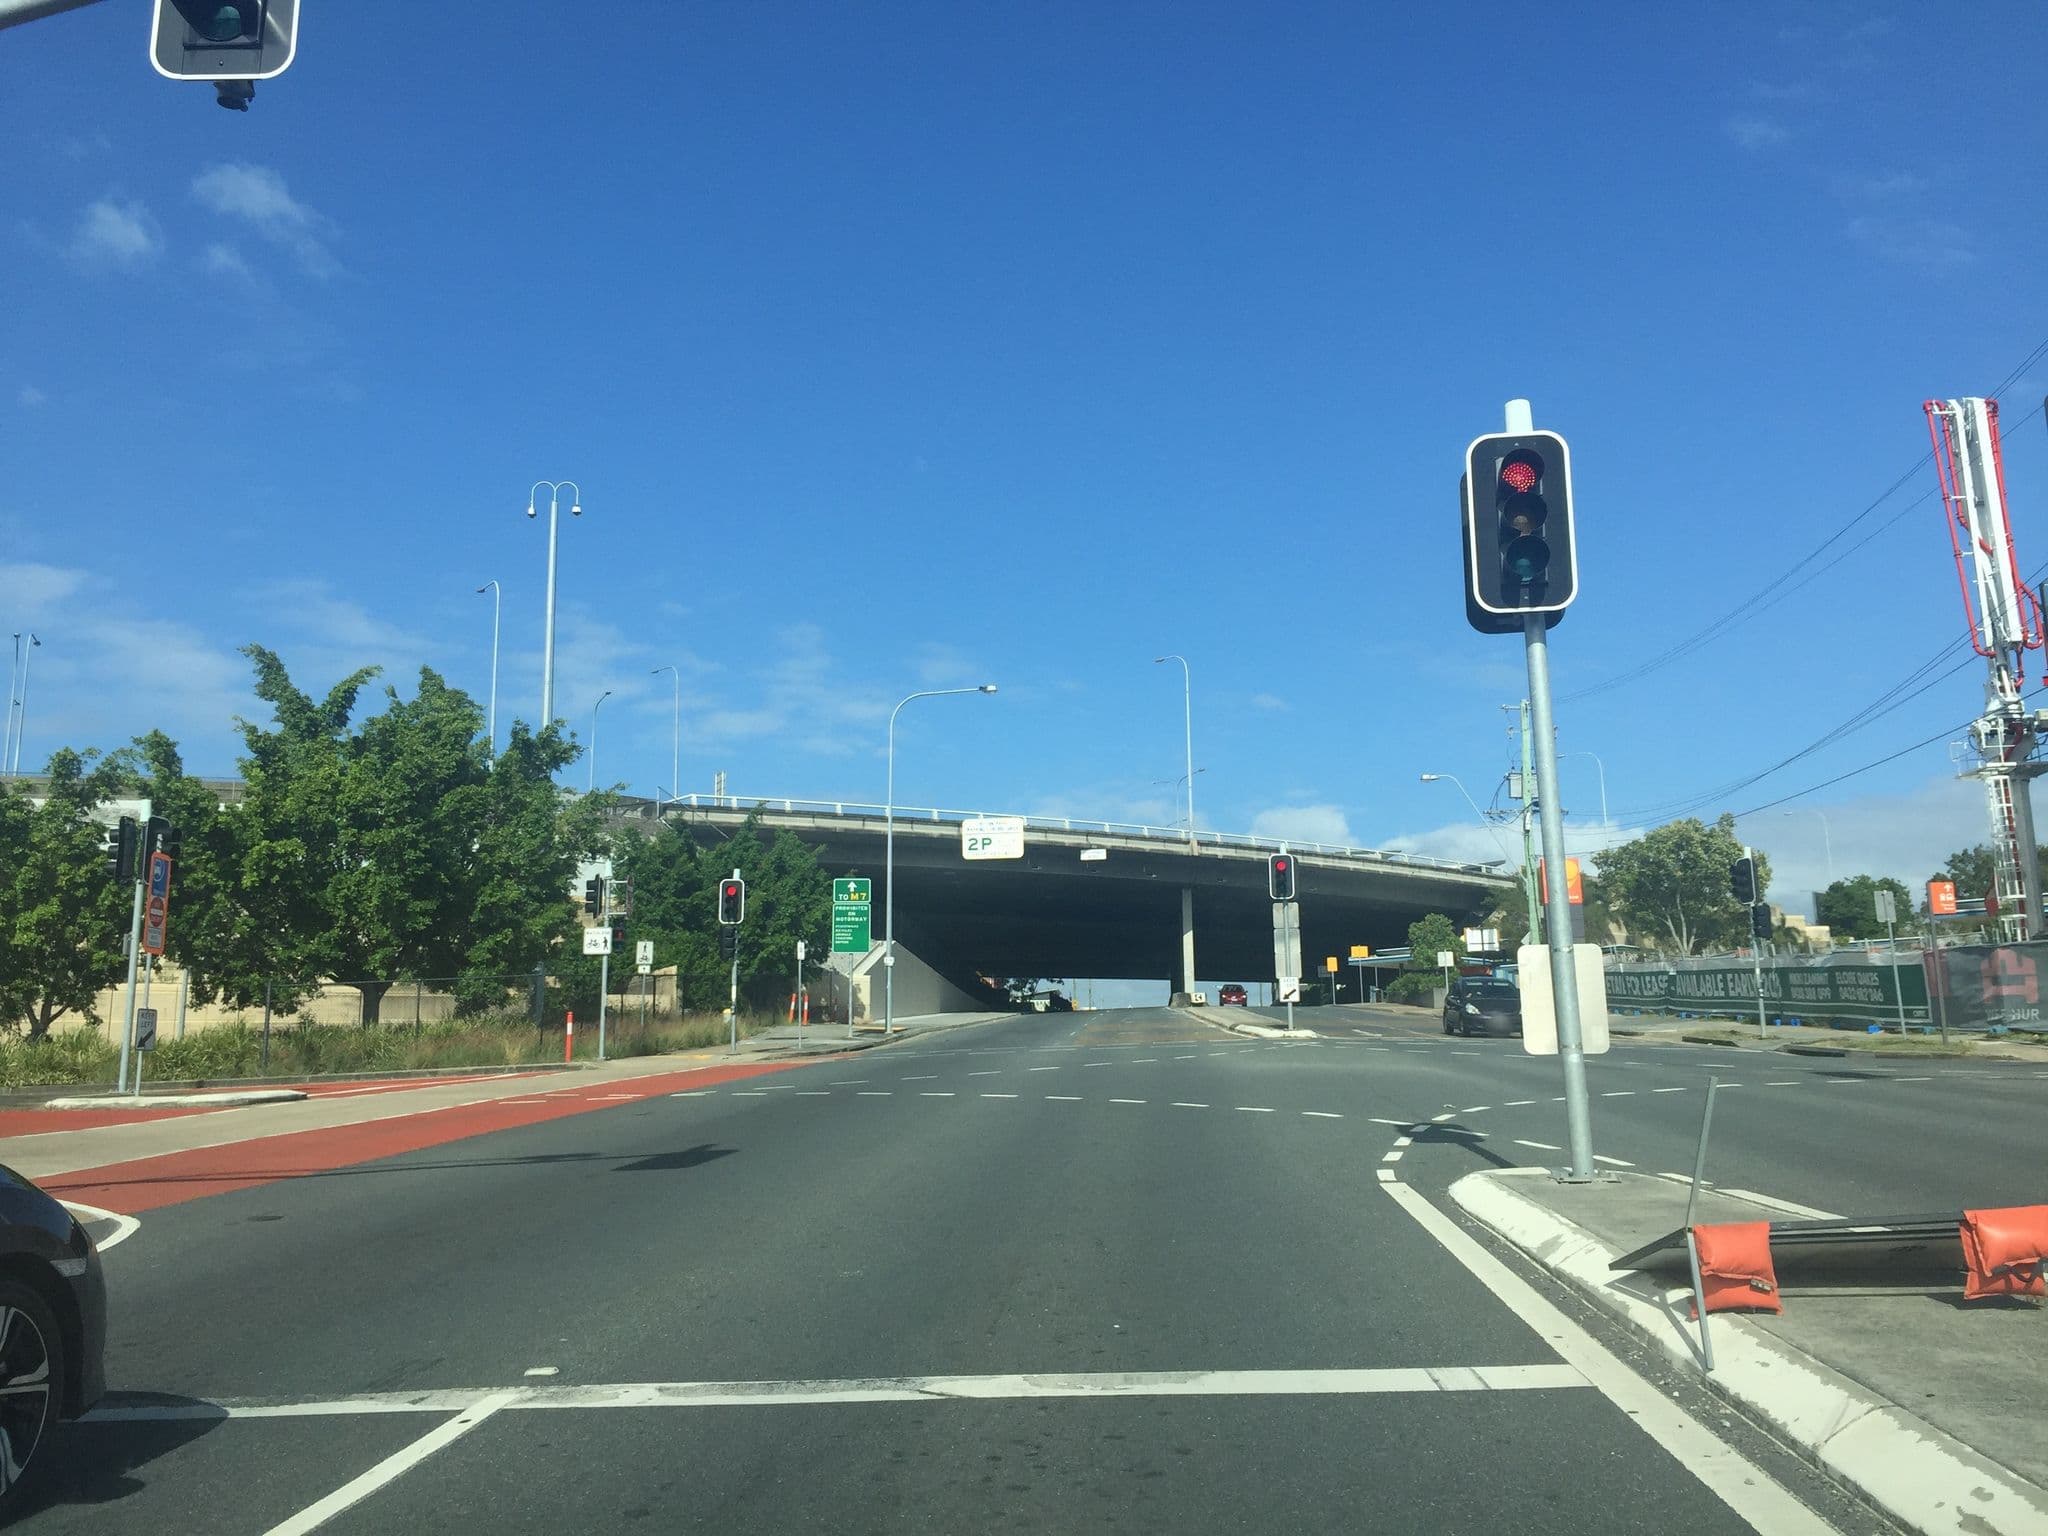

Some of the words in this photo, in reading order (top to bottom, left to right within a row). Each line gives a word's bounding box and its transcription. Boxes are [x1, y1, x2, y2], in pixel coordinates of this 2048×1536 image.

[968, 838, 992, 850] 2P
[850, 892, 867, 900] M7
[1675, 973, 1725, 997] AVAILABLE
